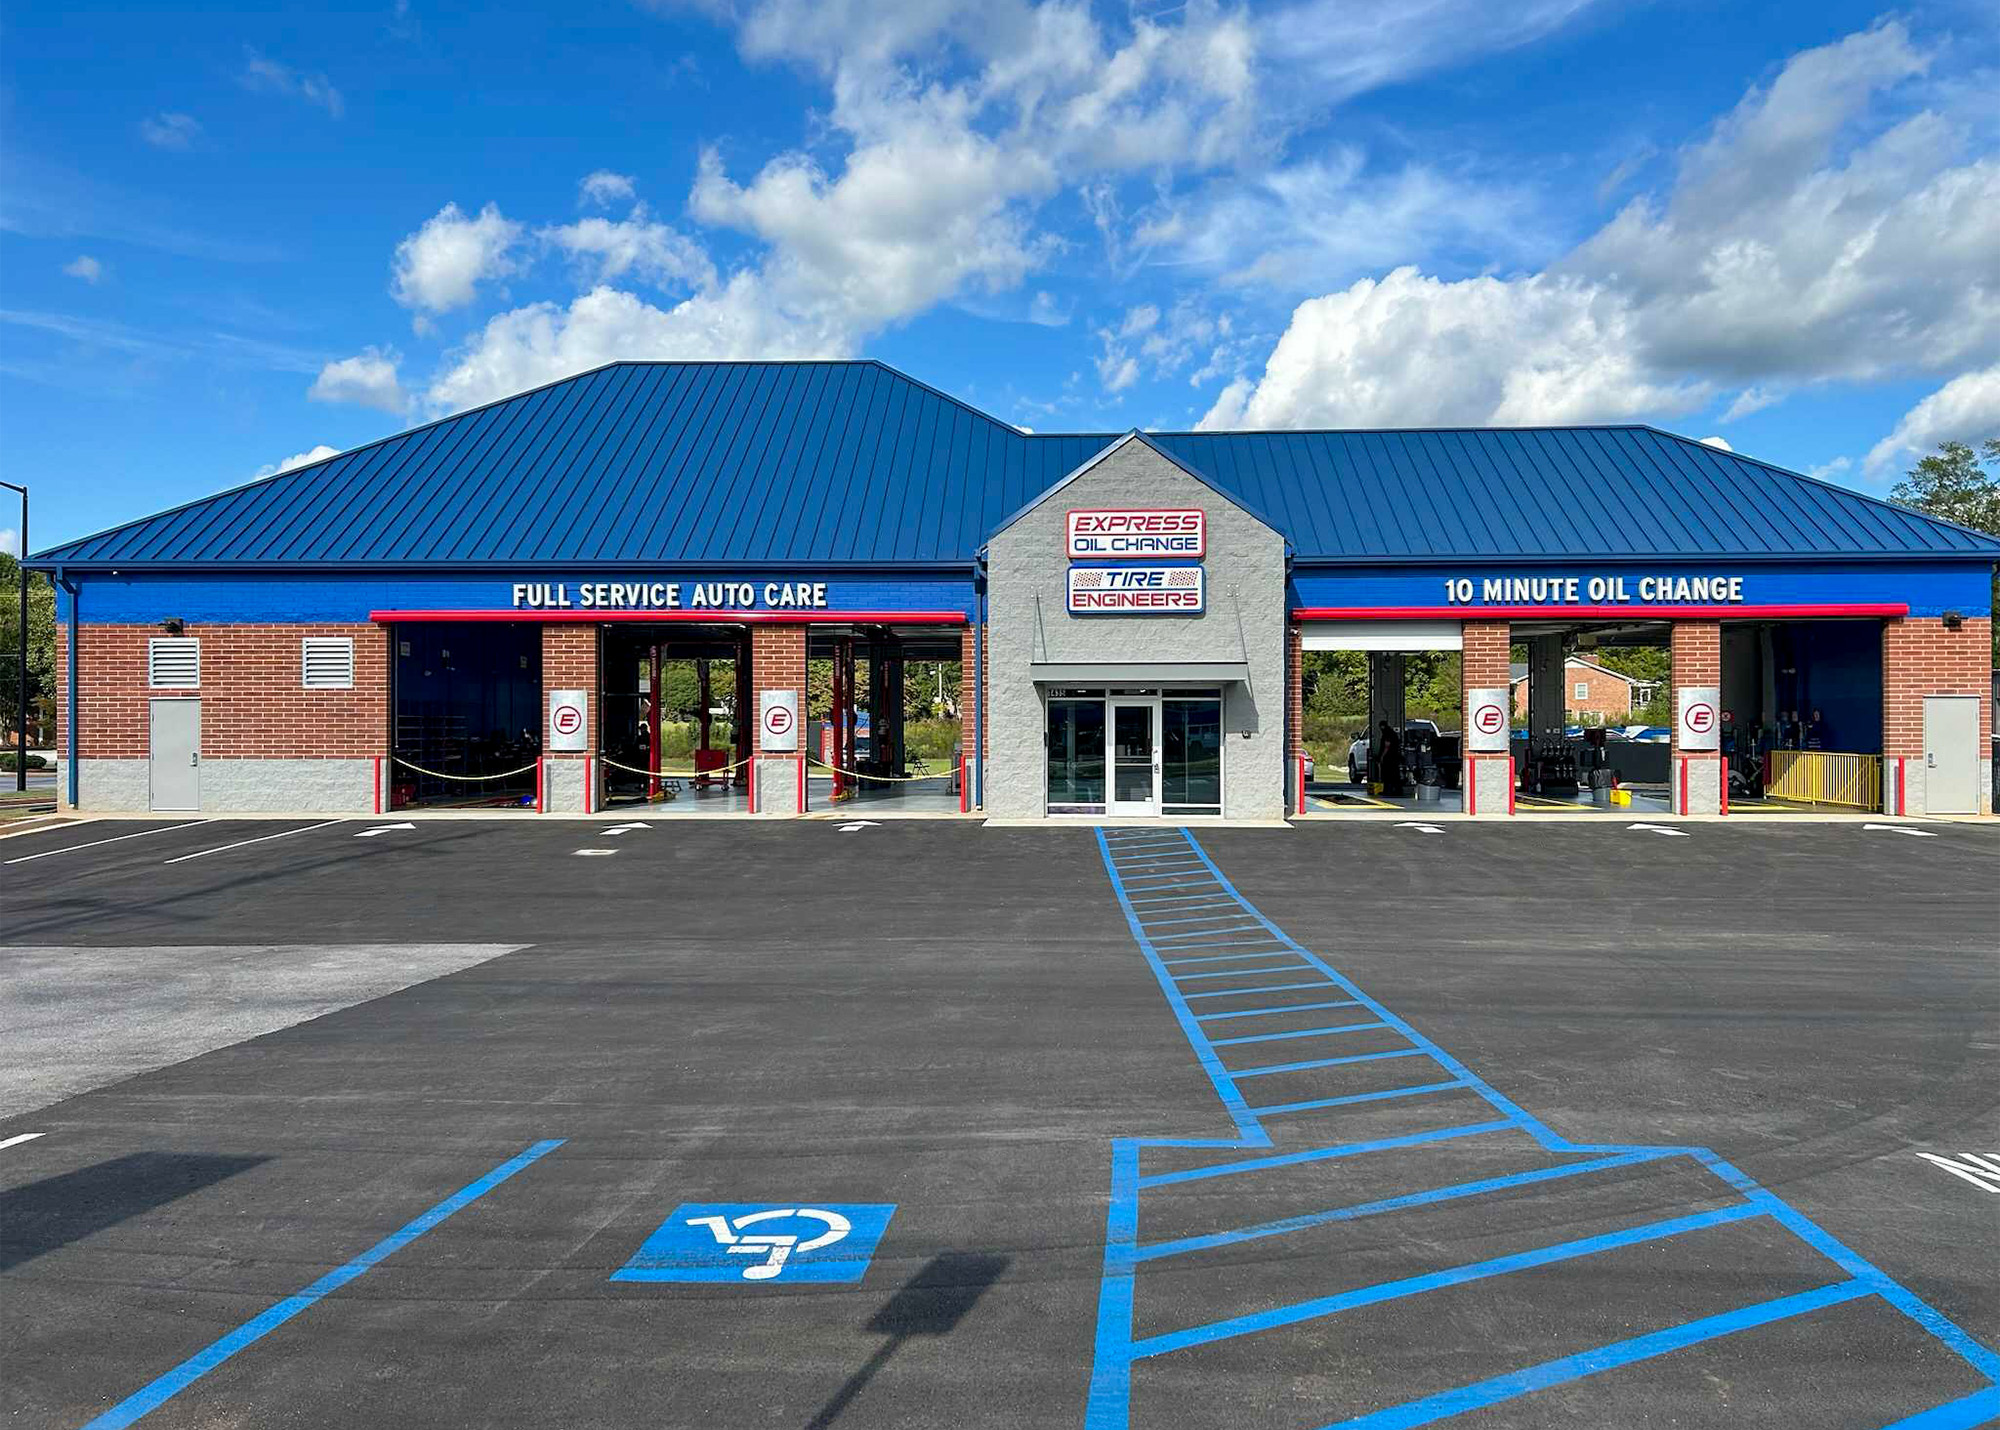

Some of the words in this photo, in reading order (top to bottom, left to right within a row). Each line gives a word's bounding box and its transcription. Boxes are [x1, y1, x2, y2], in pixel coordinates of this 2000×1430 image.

[1074, 515, 1199, 532] EXPRESS
[1074, 538, 1107, 551] OIL
[1111, 537, 1198, 551] CHANGE
[1106, 571, 1165, 587] TIRE
[512, 583, 571, 606] FULL
[579, 583, 680, 606] SERVICE
[691, 583, 755, 606] AUTO
[764, 582, 827, 606] CARE
[1445, 578, 1474, 602] 10
[1483, 578, 1579, 602] MINUTE
[1587, 577, 1630, 601] OIL
[1638, 576, 1744, 601] CHANGE
[1073, 593, 1198, 607] ENGINEERS
[560, 713, 576, 727] E
[771, 713, 787, 727] E
[1483, 713, 1499, 726] E
[1694, 712, 1710, 725] E
